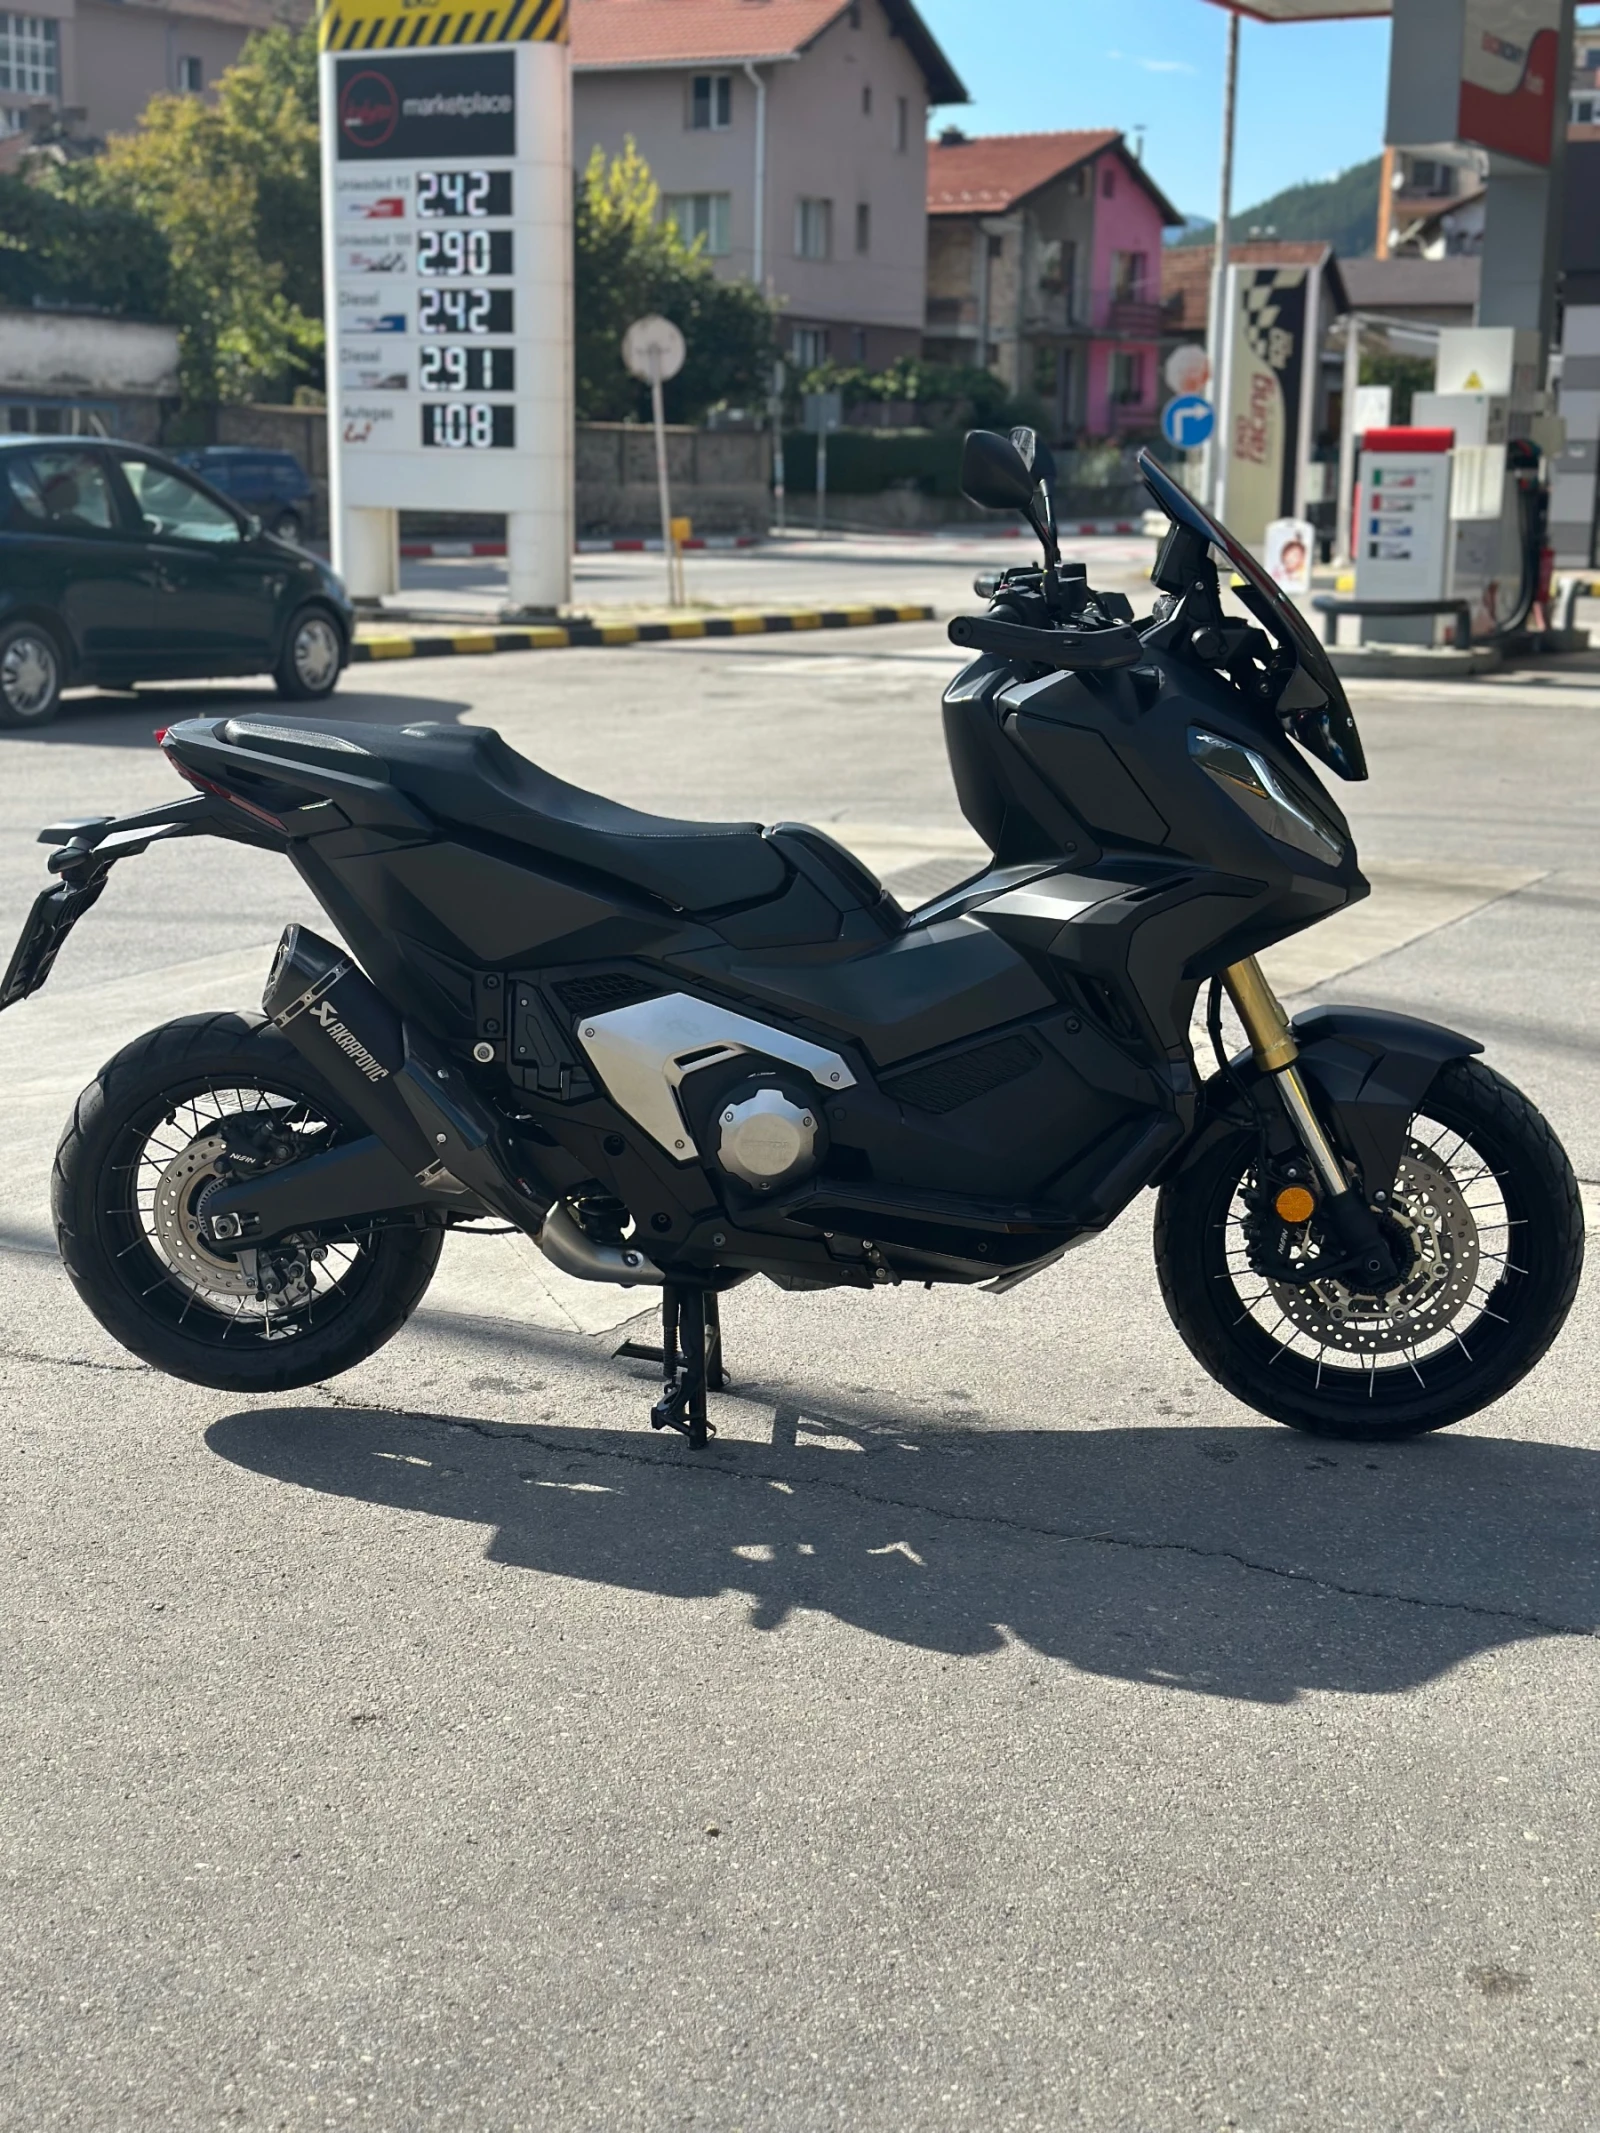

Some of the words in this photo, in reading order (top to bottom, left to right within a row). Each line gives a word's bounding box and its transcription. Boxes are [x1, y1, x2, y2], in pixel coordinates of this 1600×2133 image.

[402, 92, 512, 119] marketplace
[417, 171, 490, 217] 2.42
[417, 230, 491, 275] 2.90
[339, 290, 380, 307] Diesel
[419, 288, 492, 333] 2.42
[340, 347, 382, 364] Diesel
[326, 1022, 389, 1083] AKRAPOVIČ
